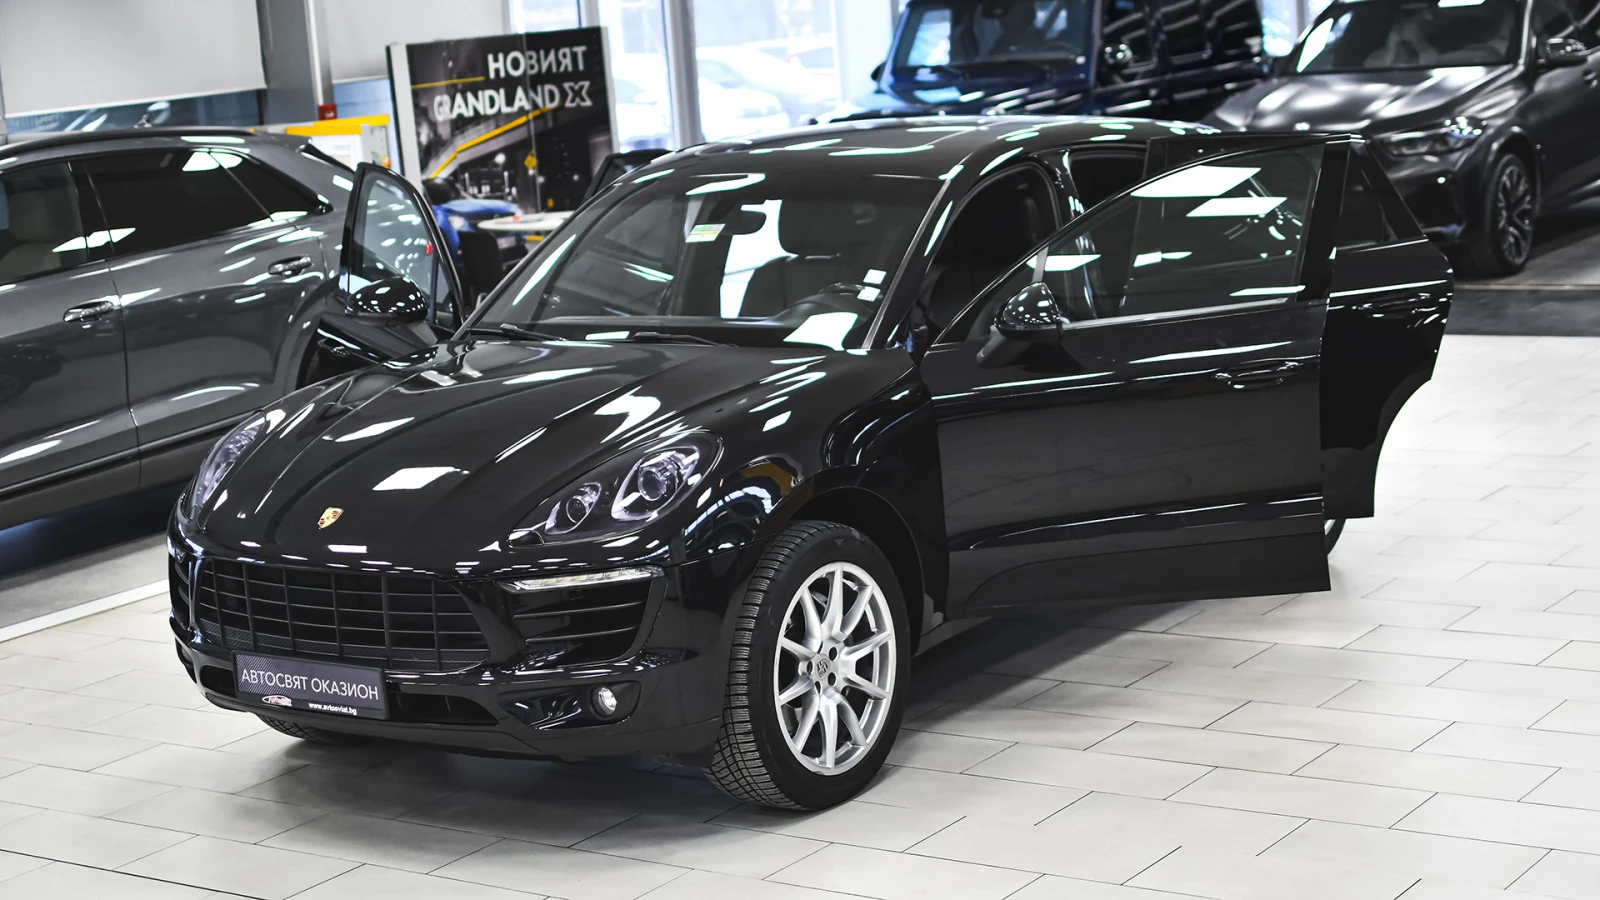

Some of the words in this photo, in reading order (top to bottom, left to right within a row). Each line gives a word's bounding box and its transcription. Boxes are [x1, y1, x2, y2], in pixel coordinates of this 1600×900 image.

[487, 46, 587, 79] НОВИЯТ
[433, 84, 560, 121] GRANDLAND
[562, 80, 593, 108] X
[241, 669, 307, 690] АВТОСВЯТ
[311, 678, 379, 700] ОКАЗИОН
[308, 702, 357, 715] www.avtosviat.bg
